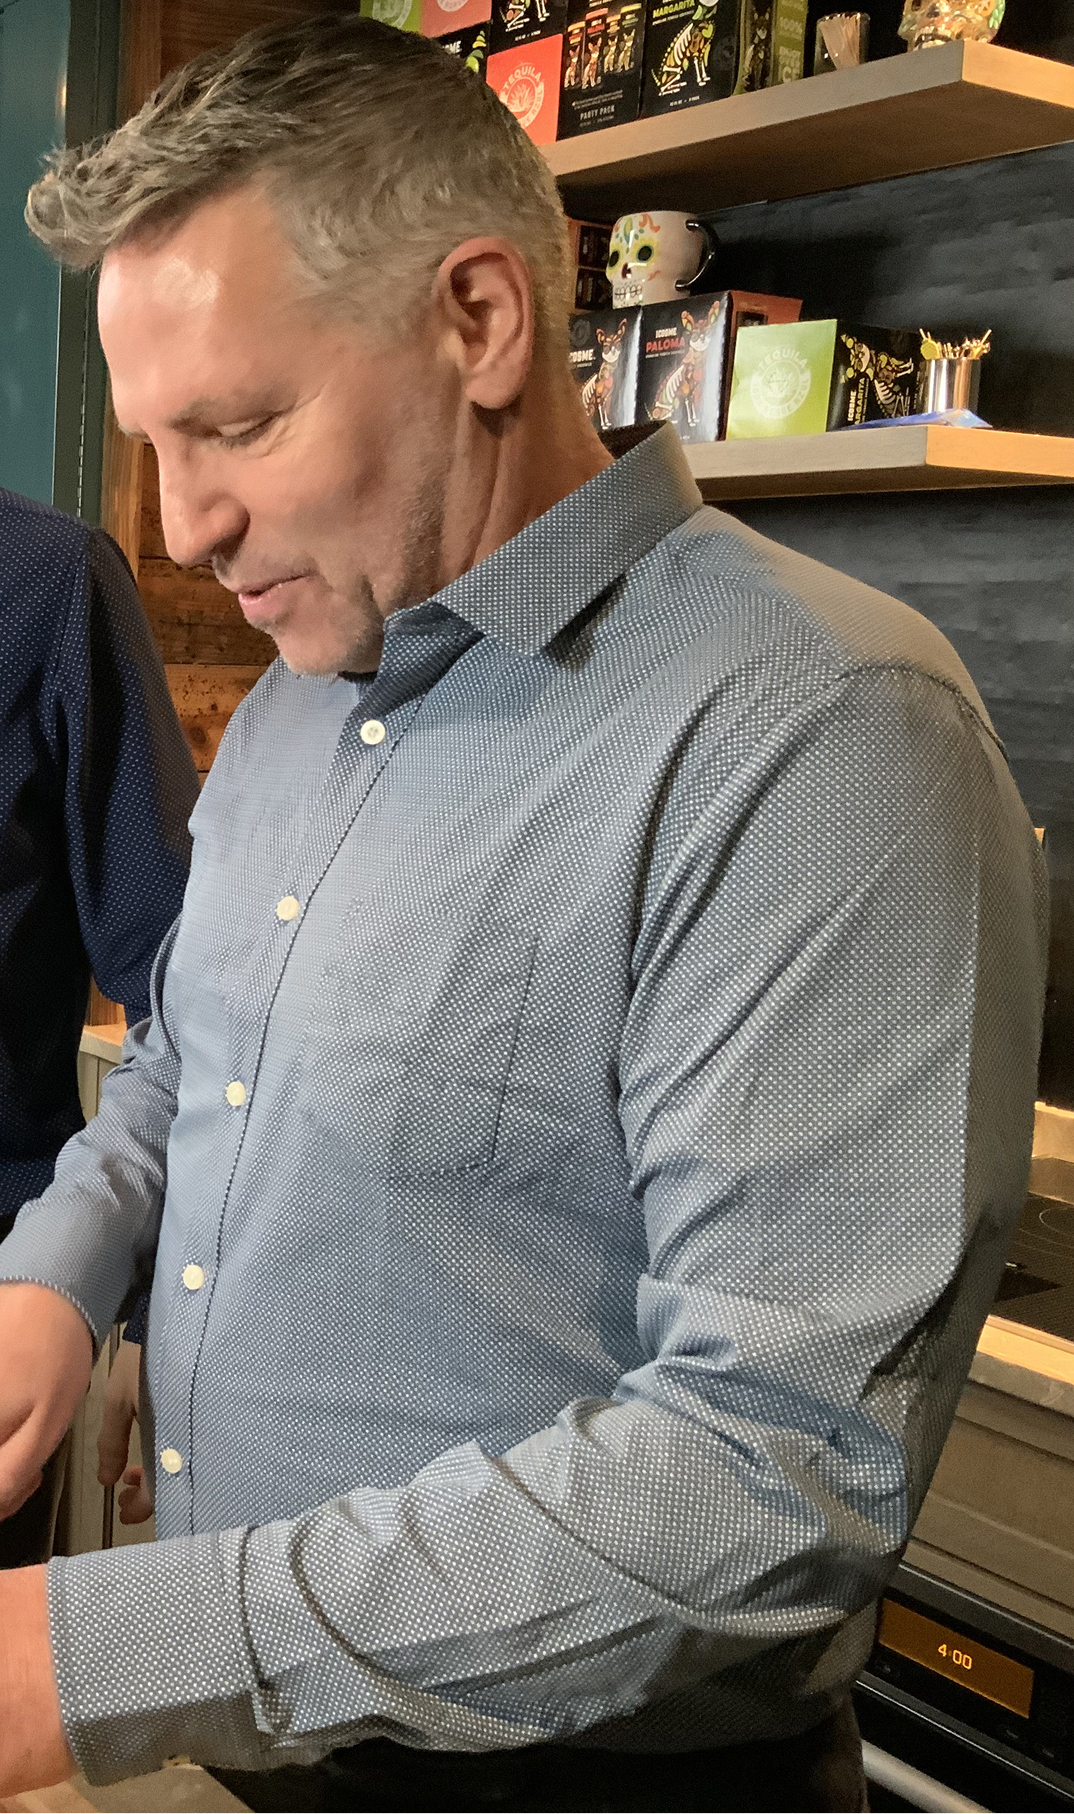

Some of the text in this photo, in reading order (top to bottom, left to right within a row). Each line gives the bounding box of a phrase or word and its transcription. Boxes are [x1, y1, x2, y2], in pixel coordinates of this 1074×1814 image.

[502, 66, 542, 90] TEQUILA
[599, 104, 615, 116] PACK
[645, 337, 686, 353] PALOMA
[758, 348, 808, 370] TEQUILA
[855, 377, 866, 425] ARGARITA
[937, 1643, 973, 1670] 4:00
